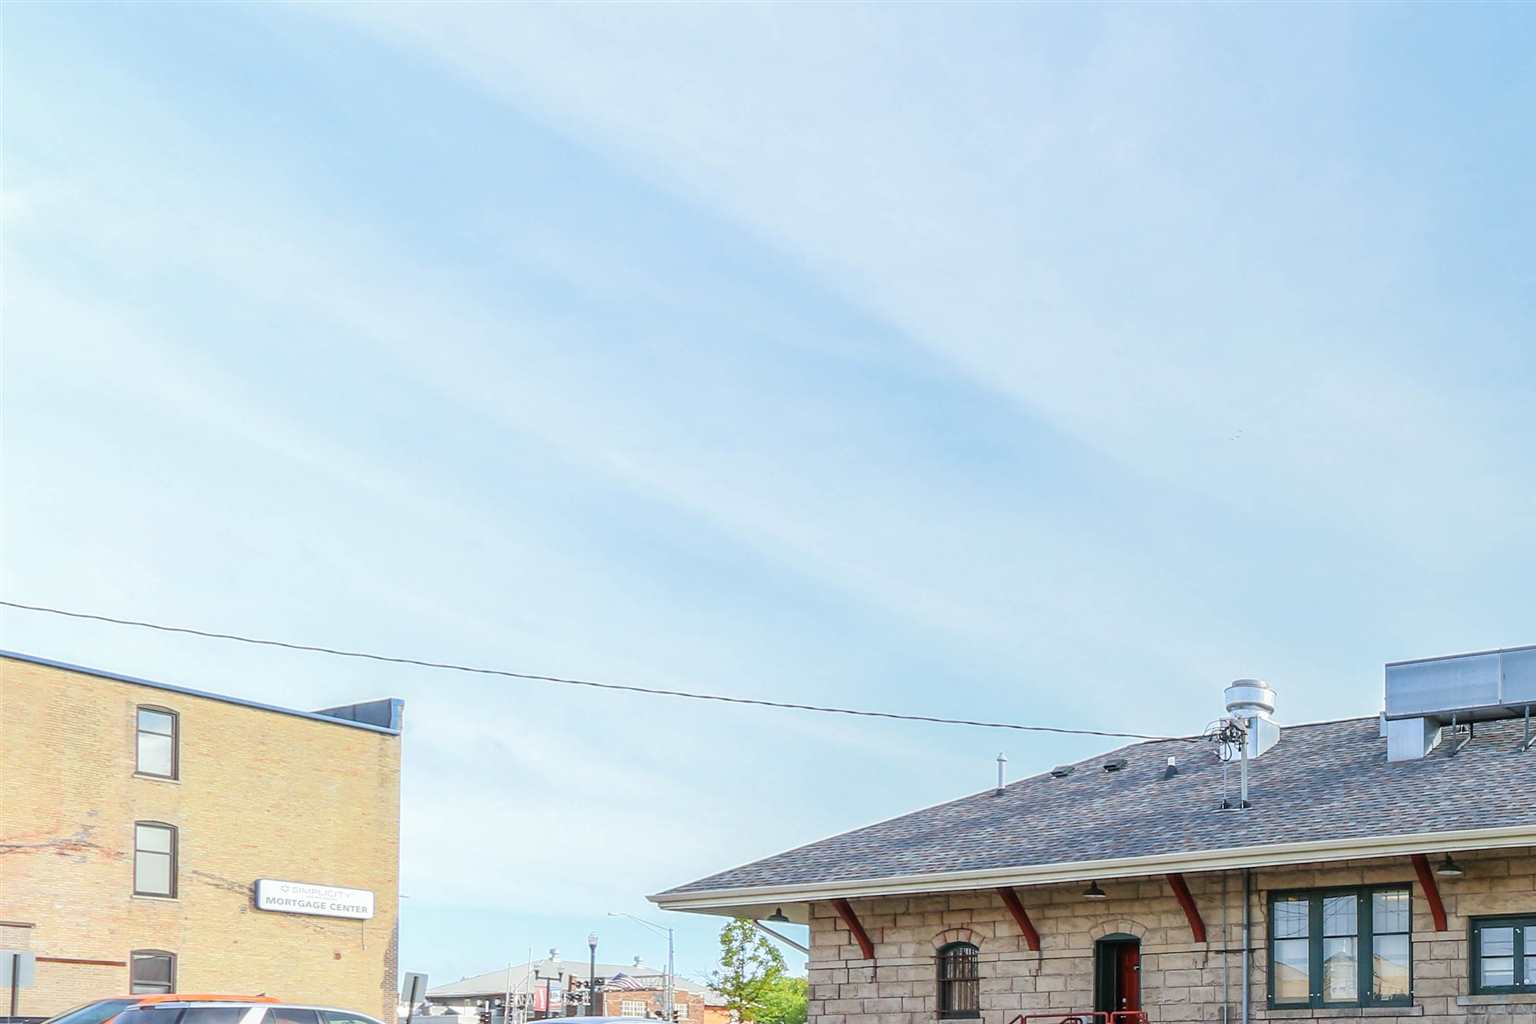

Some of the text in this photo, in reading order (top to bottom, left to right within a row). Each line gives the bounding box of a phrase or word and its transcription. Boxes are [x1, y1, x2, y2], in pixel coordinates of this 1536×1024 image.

[291, 886, 351, 899] SIMPLICITY
[265, 896, 327, 910] MORTGAGE
[329, 903, 368, 913] CENTER
